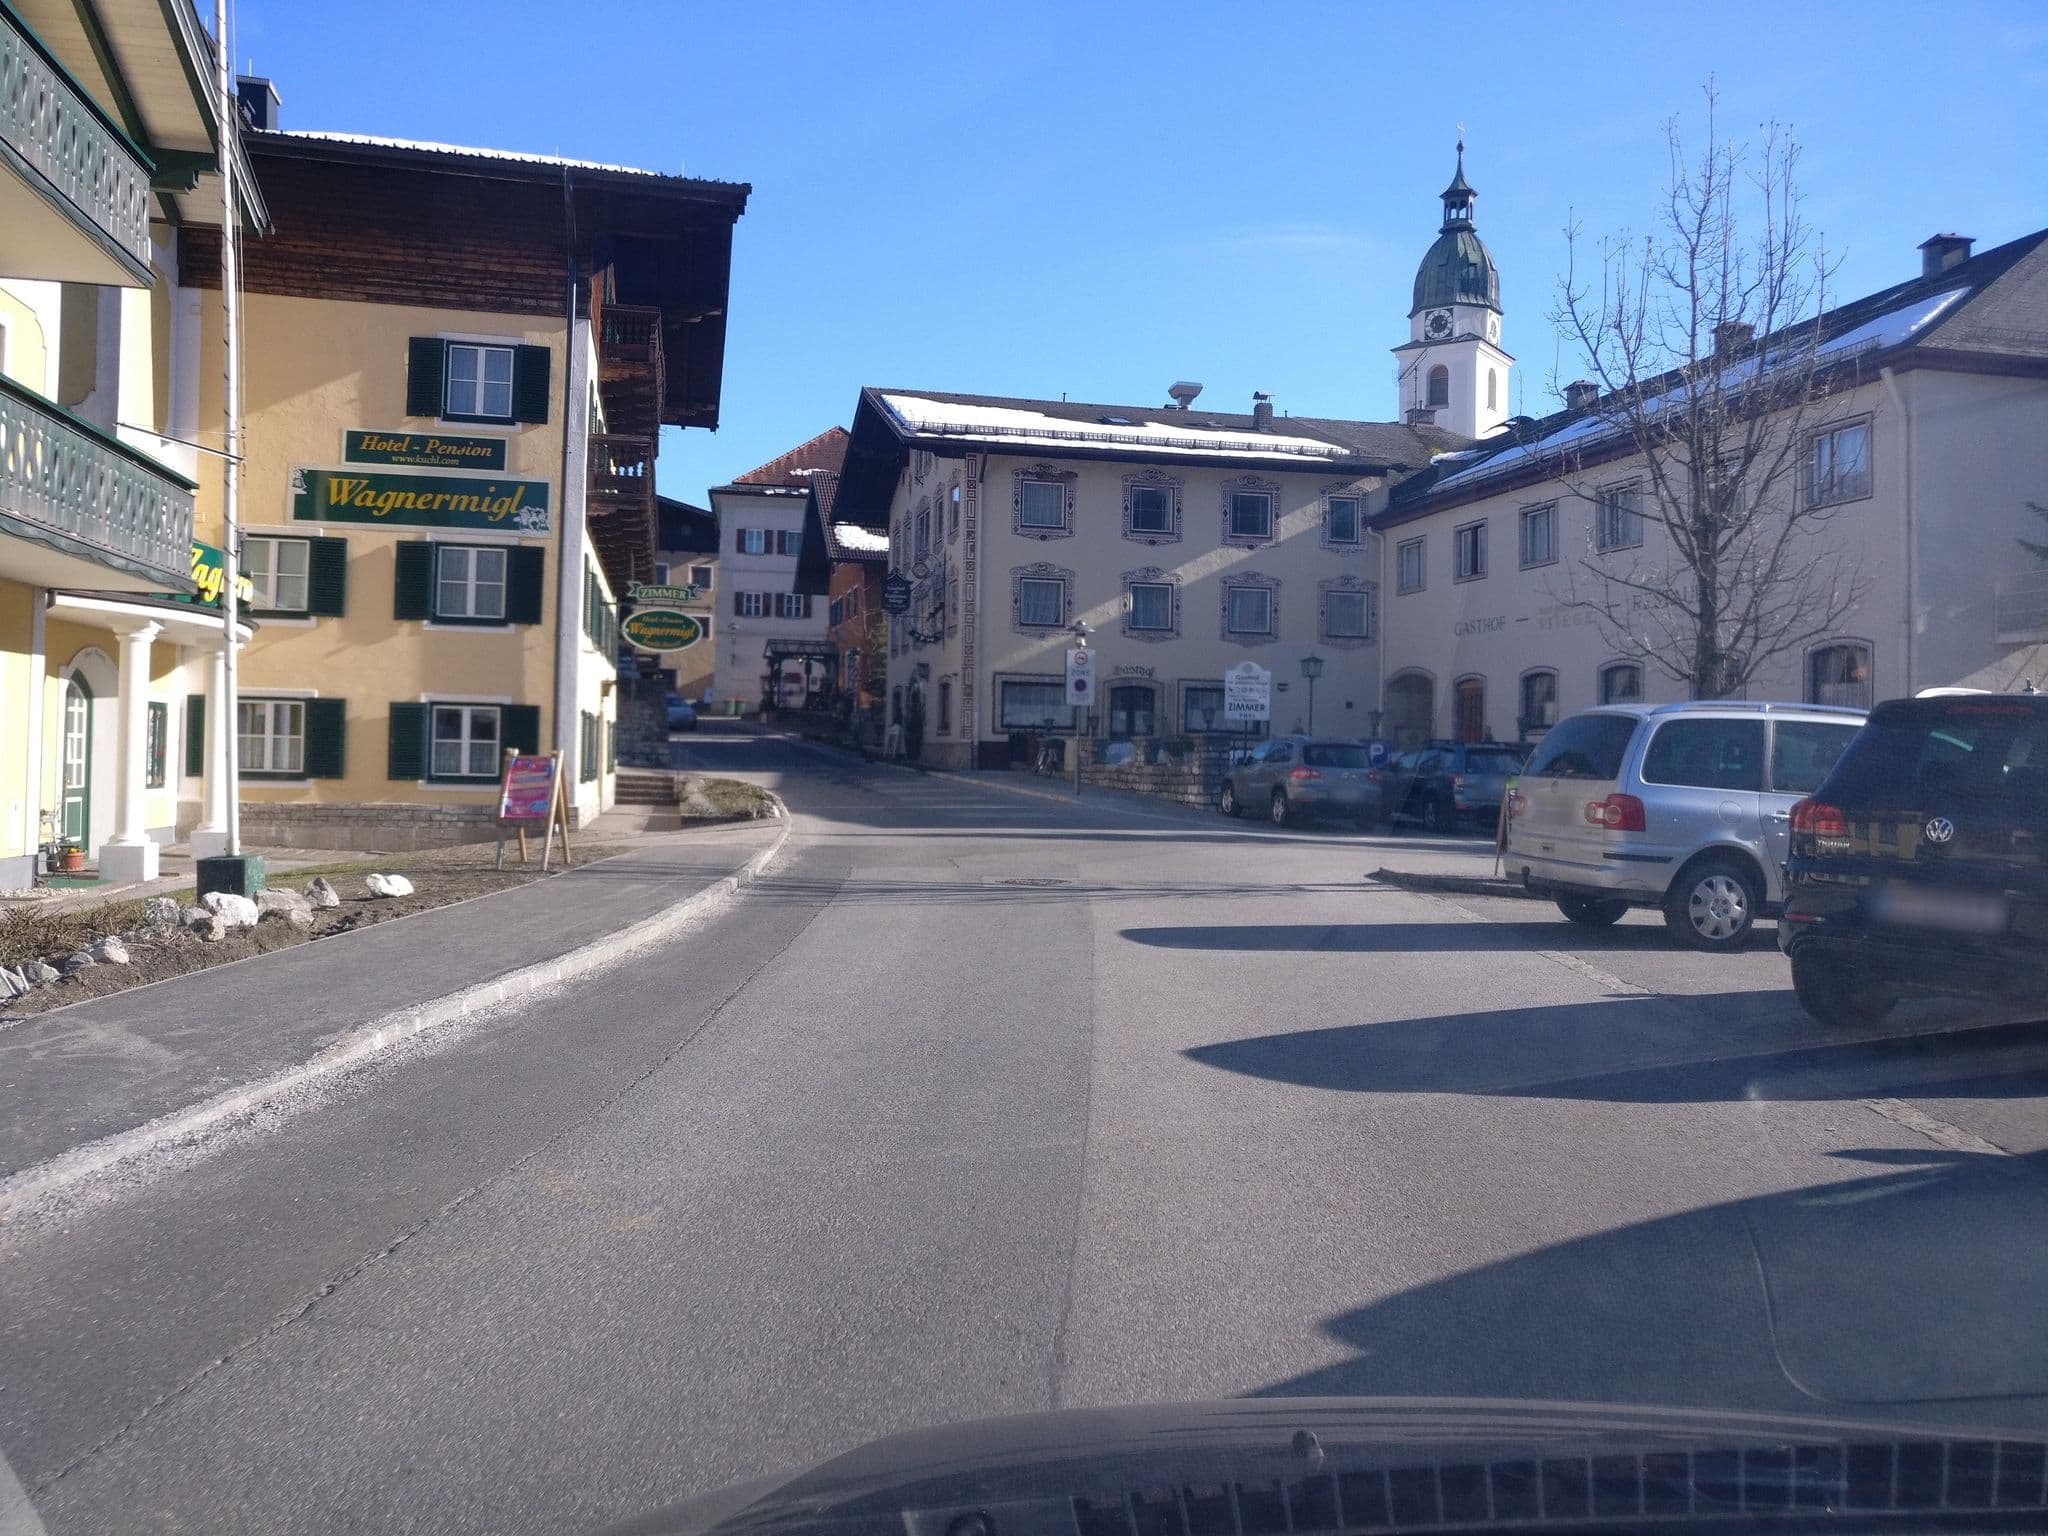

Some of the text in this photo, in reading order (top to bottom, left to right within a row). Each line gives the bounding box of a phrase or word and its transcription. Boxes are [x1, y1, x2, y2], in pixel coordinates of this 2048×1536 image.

[360, 435, 408, 452] Hotel
[426, 438, 493, 457] Pension
[391, 454, 460, 466] www.kuchl.com
[328, 477, 525, 522] Wagnermigl
[640, 588, 687, 599] ZIMMER
[630, 622, 696, 640] Wagnermigl
[1454, 615, 1507, 636] GASTHOF
[1228, 702, 1266, 712] ZIMMER
